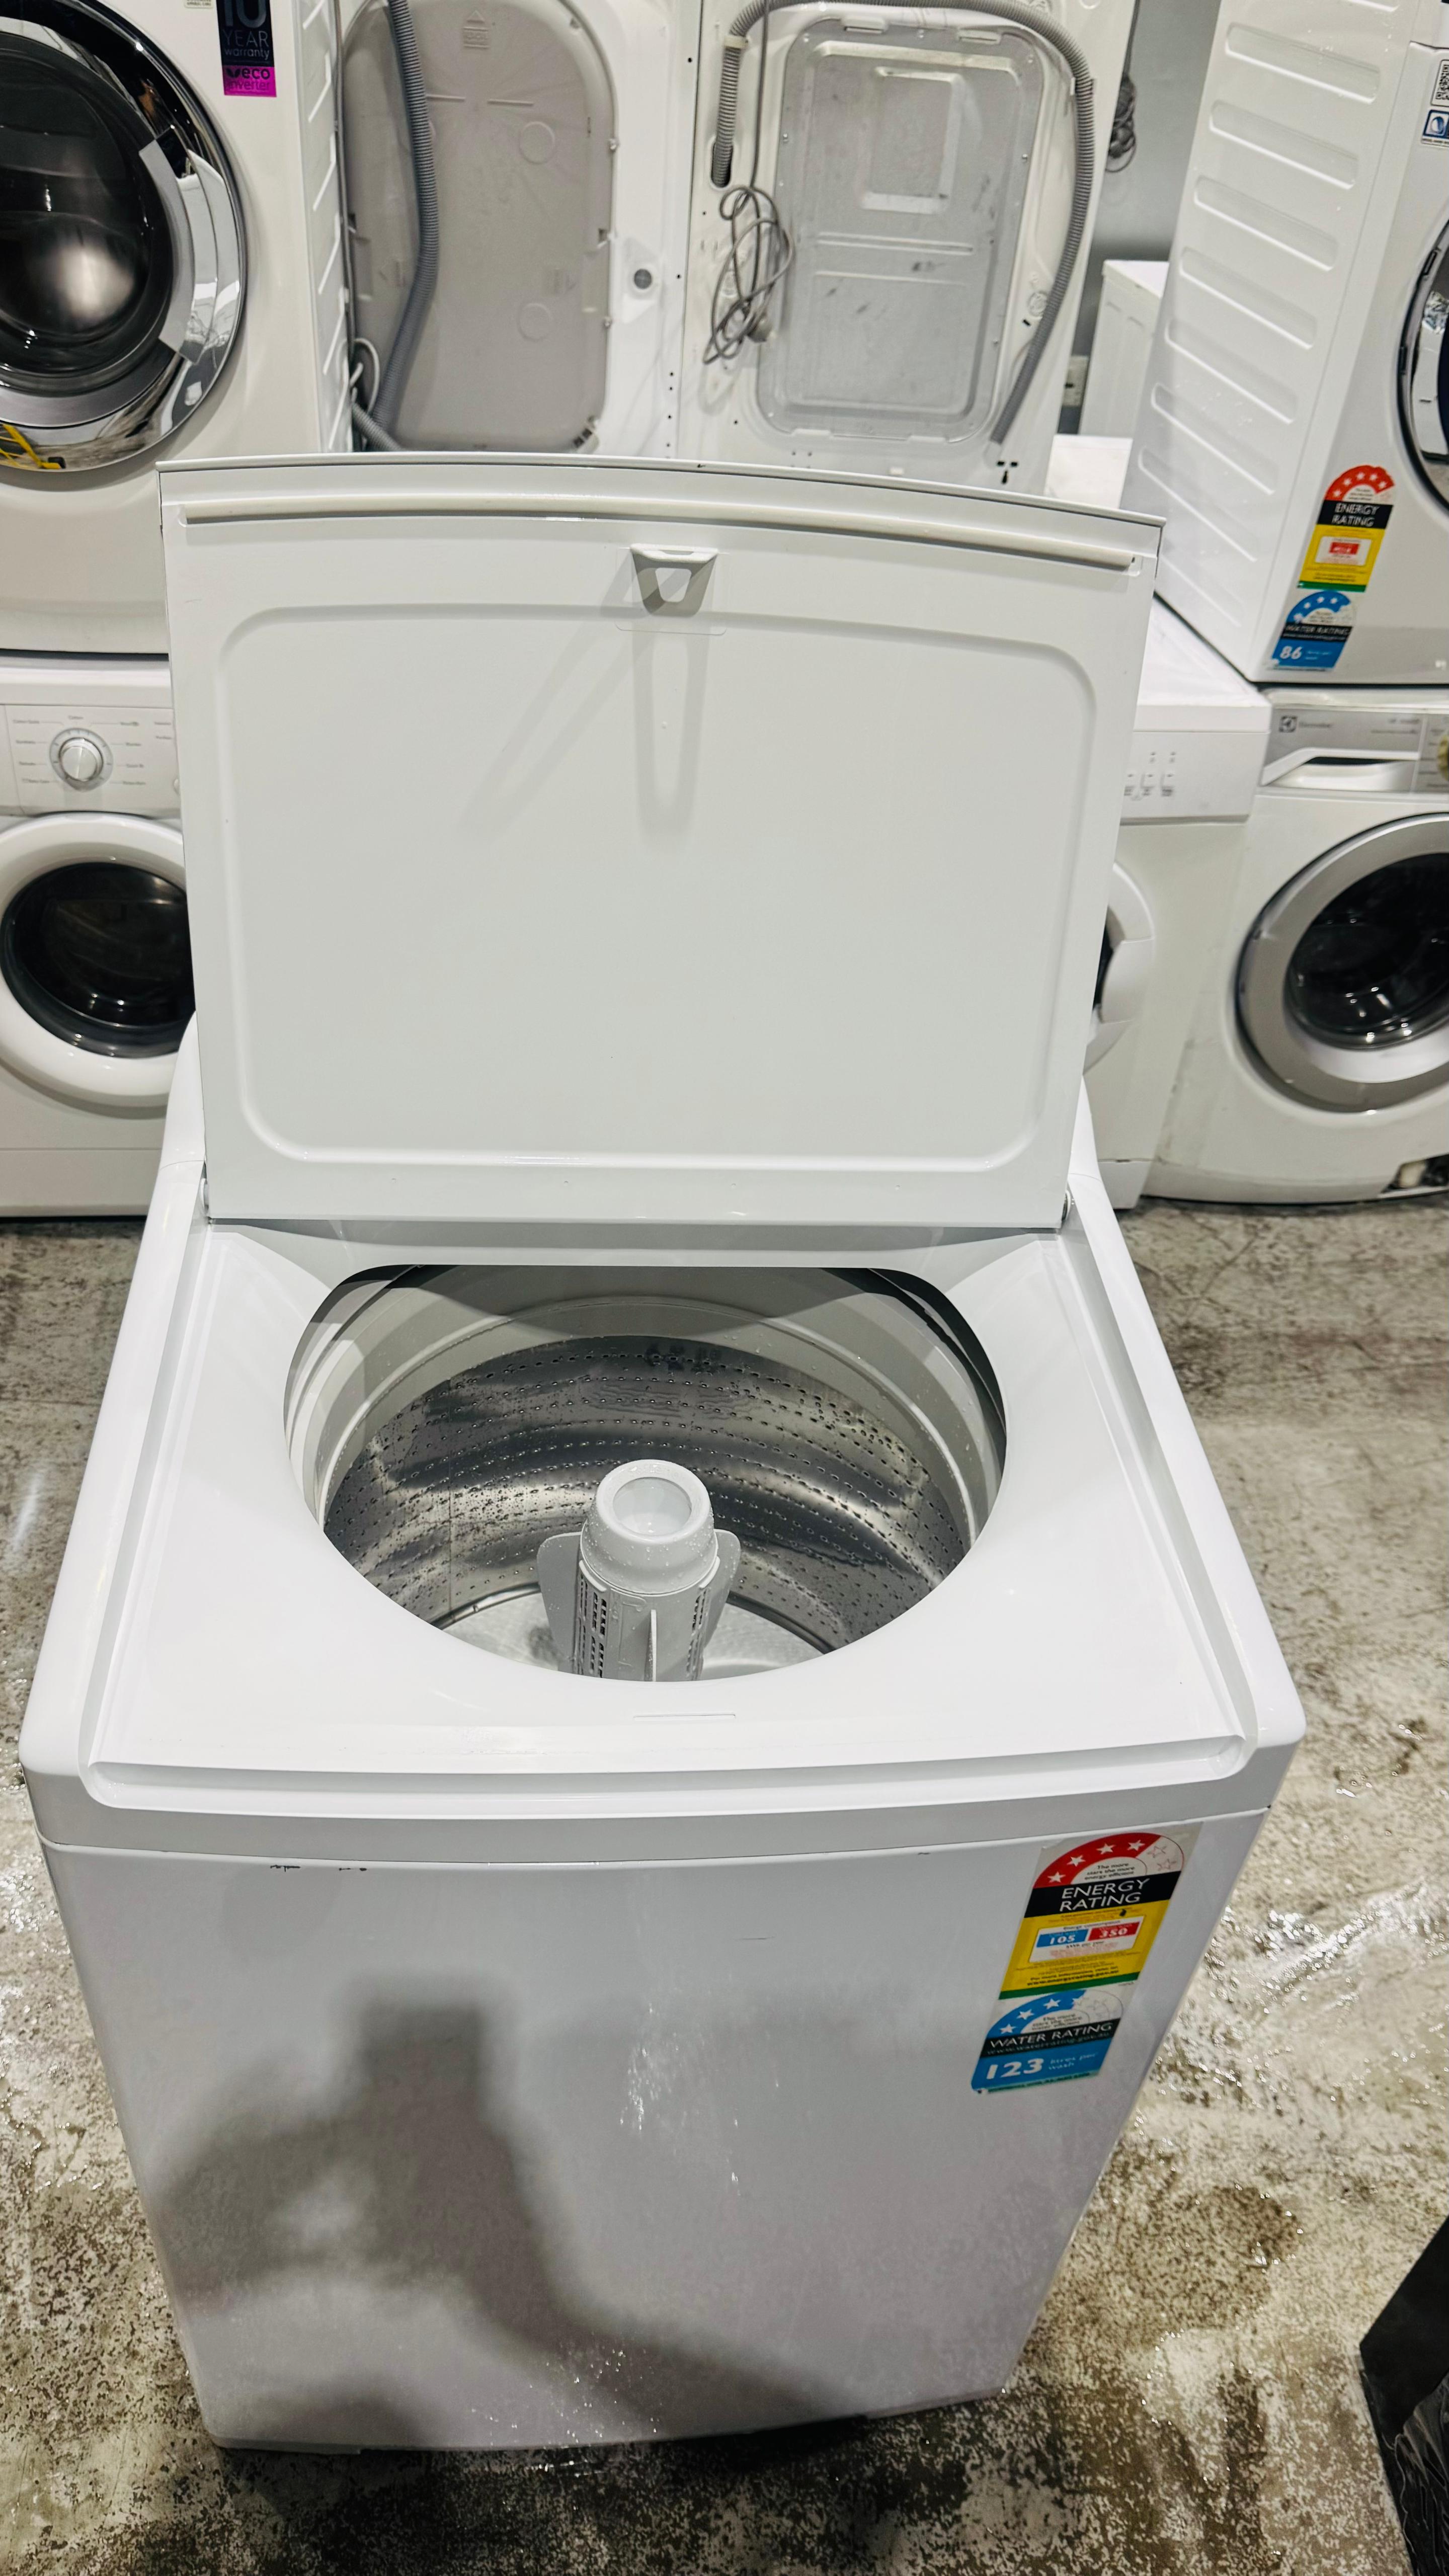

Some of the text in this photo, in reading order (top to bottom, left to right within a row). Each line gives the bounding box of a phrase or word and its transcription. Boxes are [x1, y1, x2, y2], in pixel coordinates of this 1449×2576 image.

[222, 30, 269, 48] YEAR
[225, 48, 270, 60] warranty
[242, 68, 270, 79] eco
[227, 80, 270, 91] inverter
[1335, 503, 1380, 515] ENERGY
[1331, 514, 1375, 527] RATING
[1279, 646, 1303, 660] 86
[1062, 1878, 1150, 1899] ENERGY
[1060, 1892, 1142, 1912] RATING
[1050, 1927, 1128, 1945] 105 350
[990, 2023, 1113, 2048] WATER RATING
[986, 2058, 1044, 2079] 123
